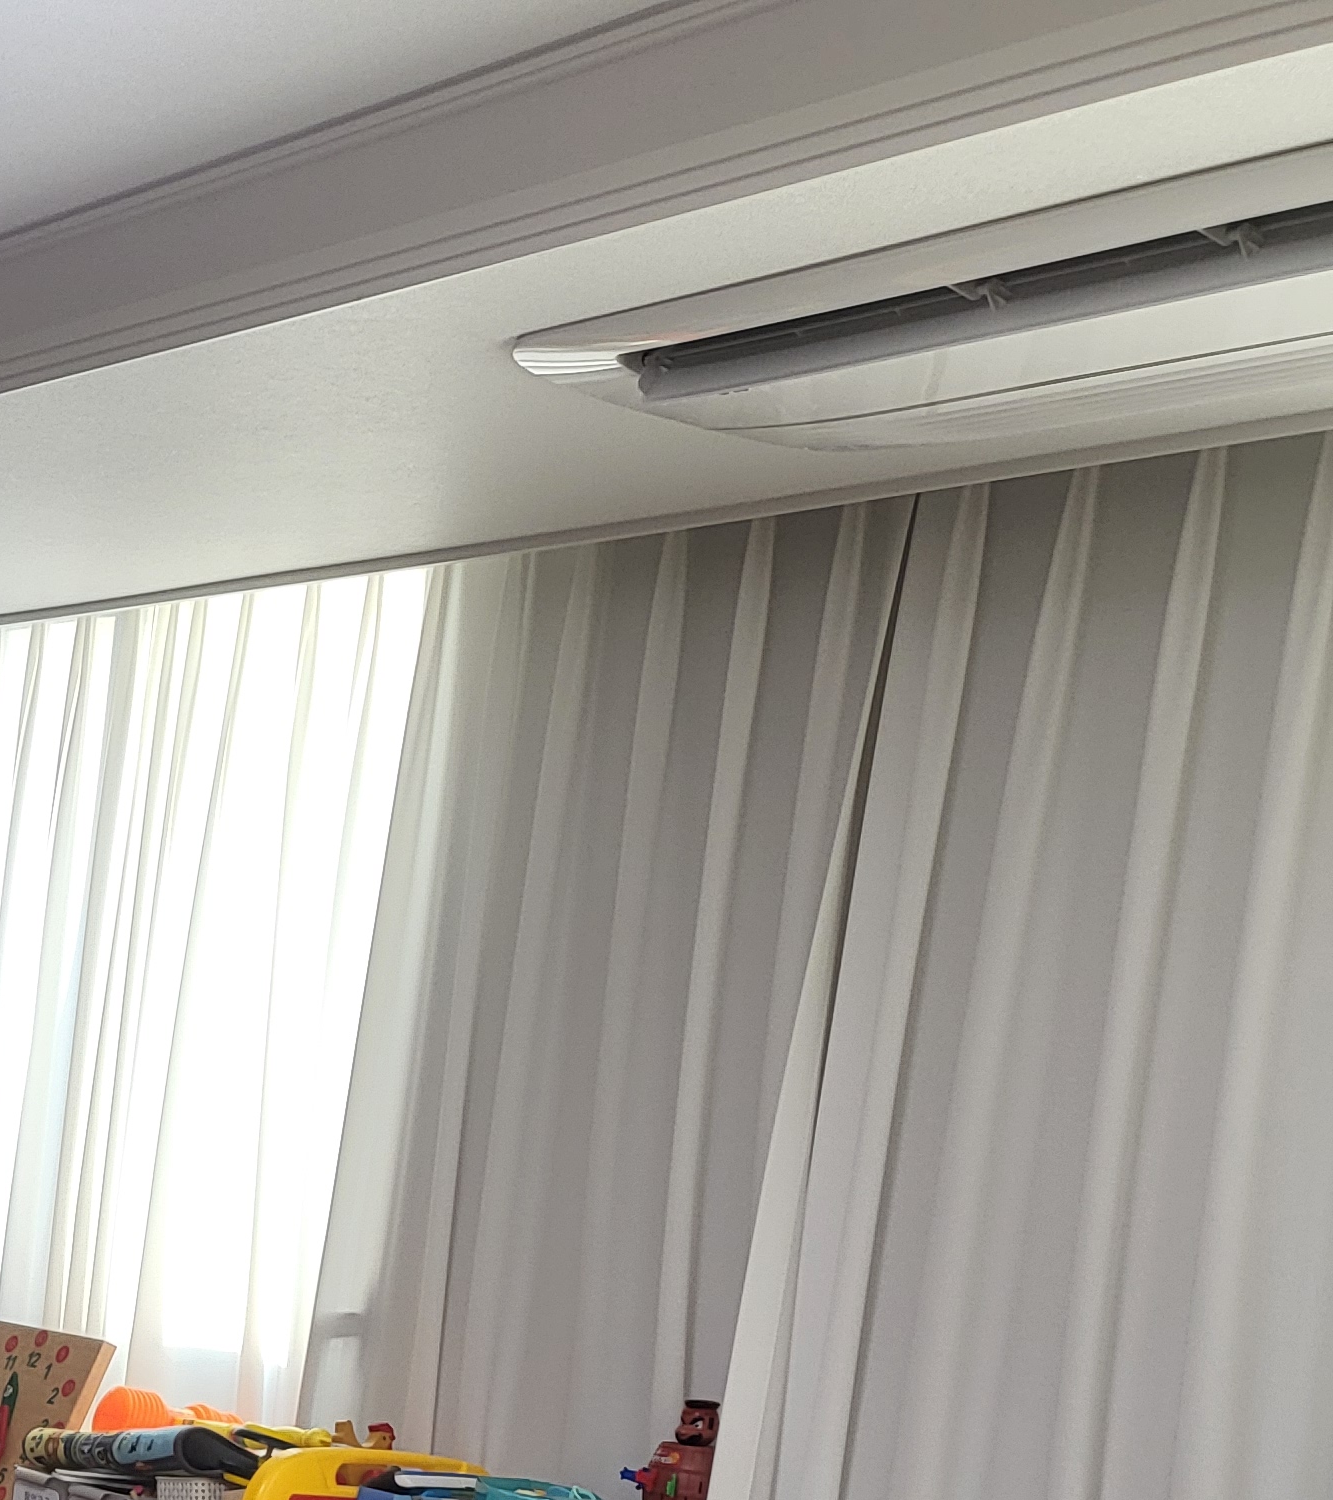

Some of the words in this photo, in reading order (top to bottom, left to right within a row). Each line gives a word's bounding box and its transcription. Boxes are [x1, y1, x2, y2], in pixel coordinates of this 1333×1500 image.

[4, 1354, 18, 1371] 11
[26, 1351, 42, 1368] 12
[43, 1362, 53, 1380] 1
[46, 1387, 60, 1405] 2
